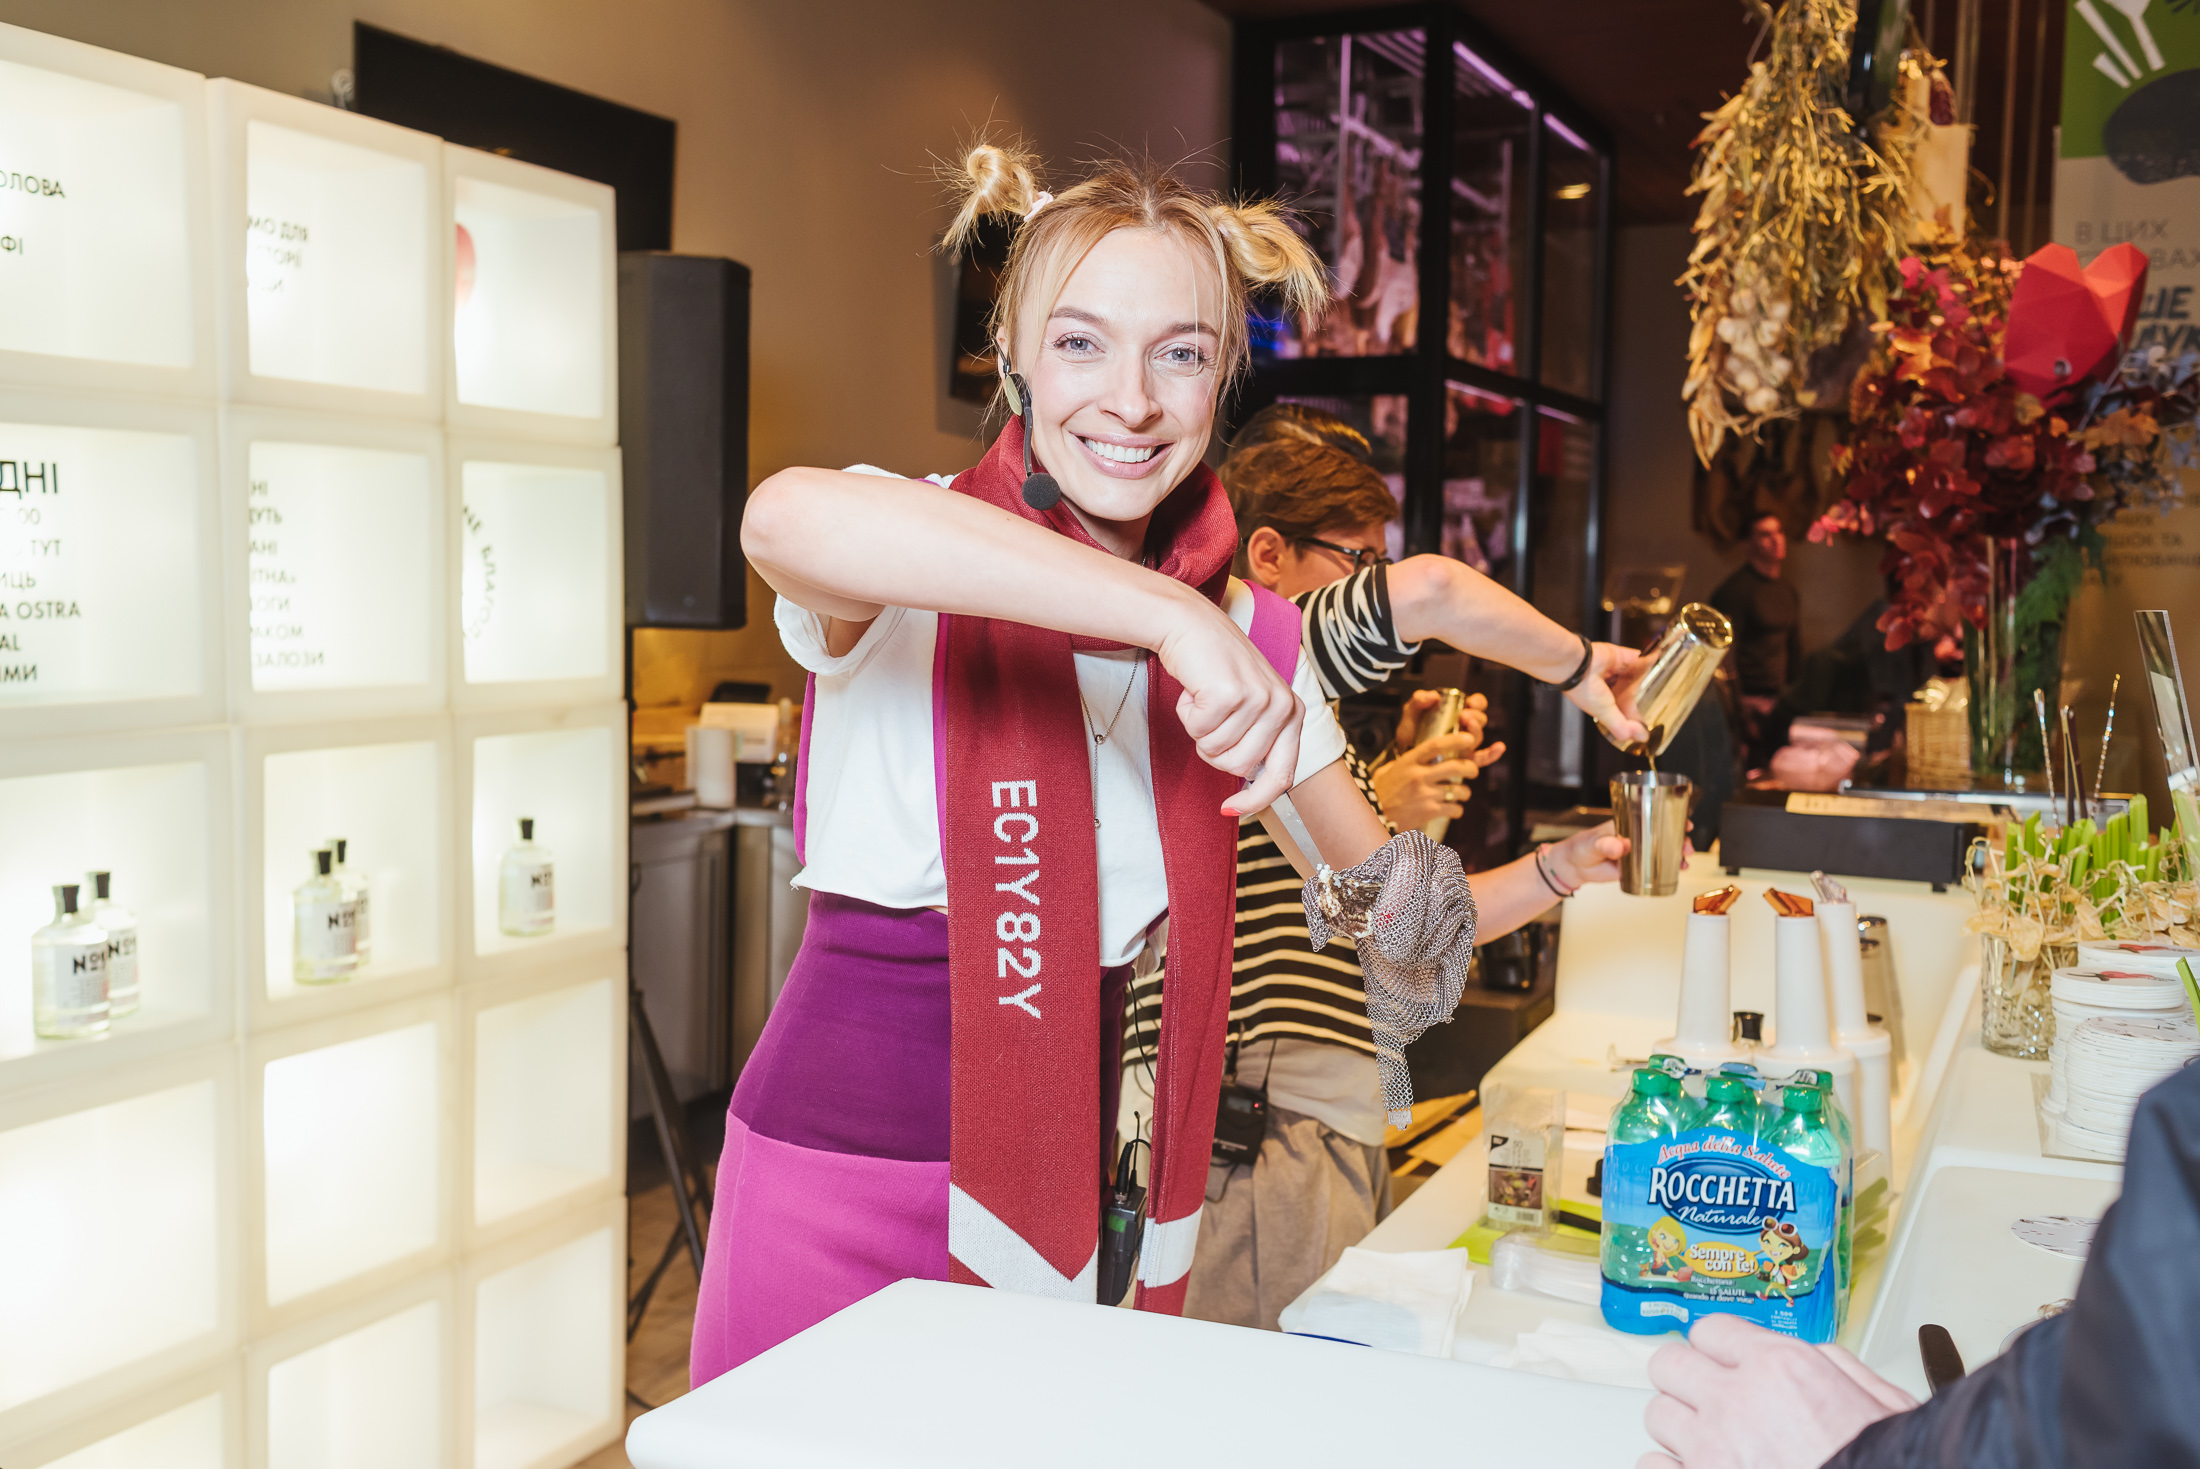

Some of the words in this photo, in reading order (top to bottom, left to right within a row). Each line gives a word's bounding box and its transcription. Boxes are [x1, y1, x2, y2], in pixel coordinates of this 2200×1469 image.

[0, 460, 58, 500] ДНІ
[16, 600, 82, 621] OSTRA
[1657, 1140, 1700, 1165] Acqua
[1702, 1135, 1742, 1154] della
[1742, 1145, 1791, 1180] Salute
[1648, 1167, 1796, 1212] ROCCHETTA
[1678, 1206, 1763, 1226] Naturale
[1689, 1244, 1745, 1262] Sempre
[1705, 1260, 1733, 1272] con
[1736, 1259, 1755, 1273] te!
[1718, 1288, 1747, 1296] SALUTE
